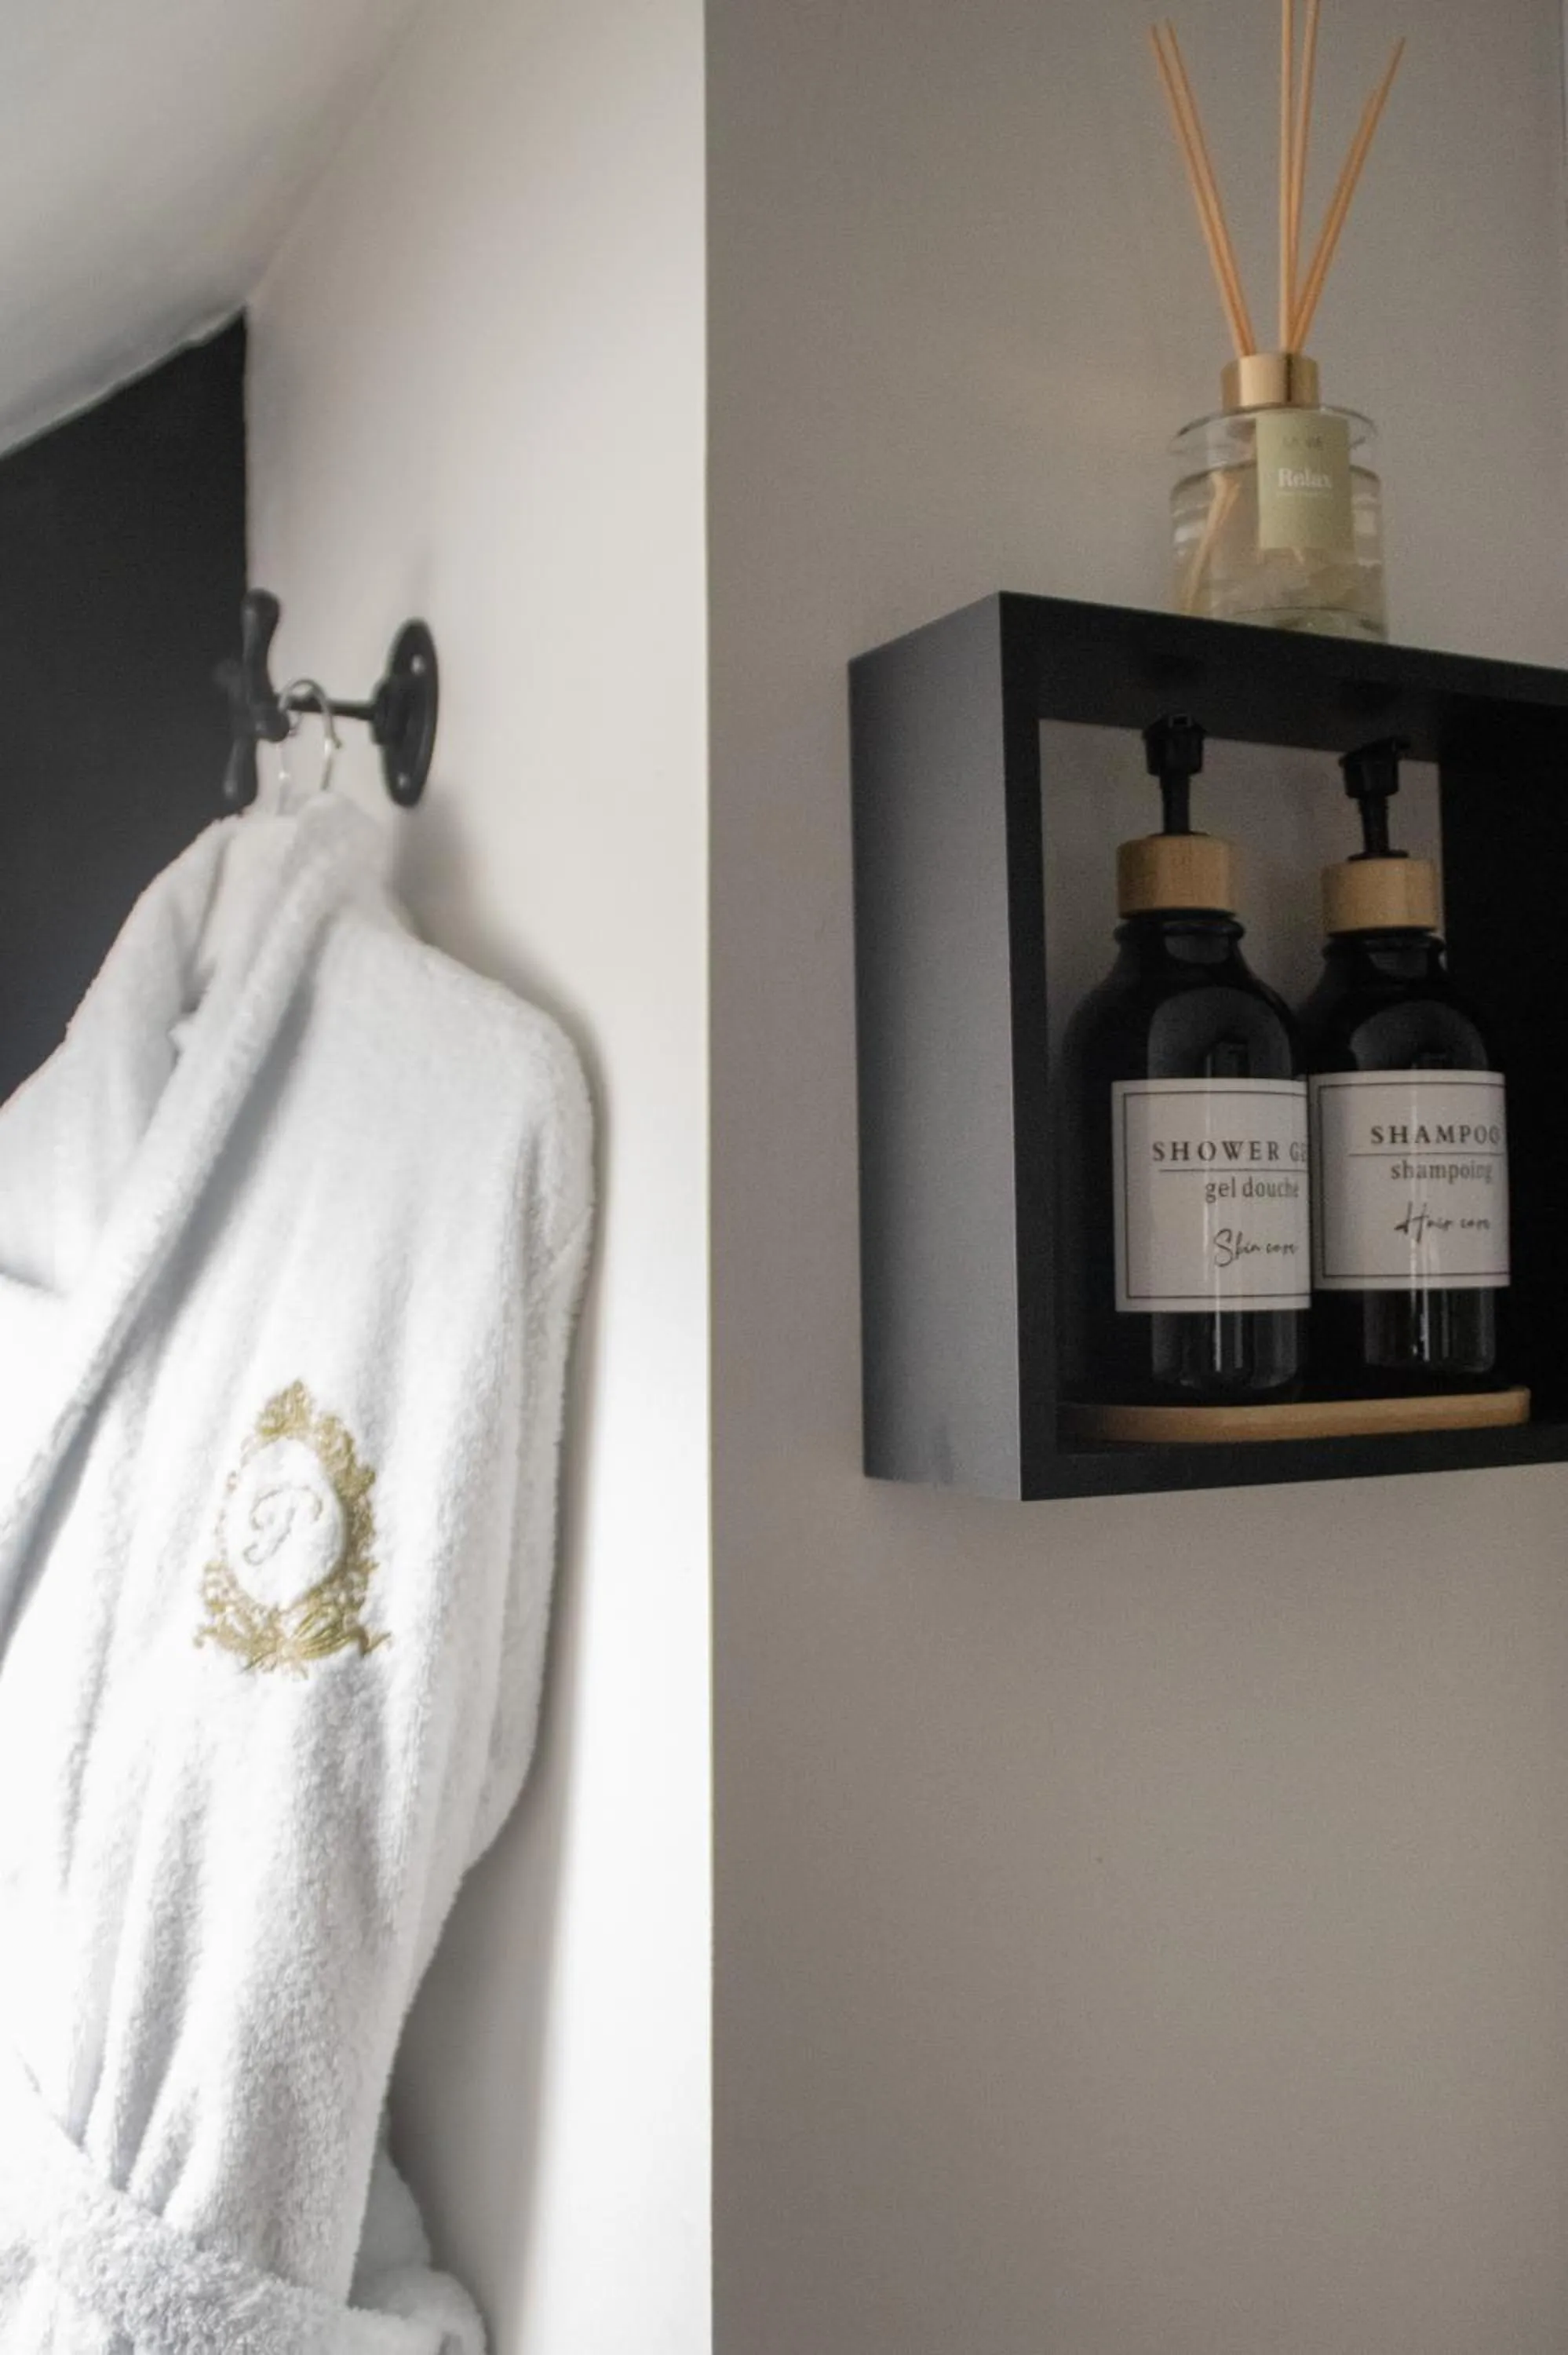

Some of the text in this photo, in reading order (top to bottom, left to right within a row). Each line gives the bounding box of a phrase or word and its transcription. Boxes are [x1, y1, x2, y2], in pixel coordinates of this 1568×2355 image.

[1151, 1140, 1280, 1163] SHOWER
[1390, 1159, 1493, 1185] shampoing
[1205, 1176, 1300, 1203] gel douche
[1213, 1227, 1261, 1268] Skin
